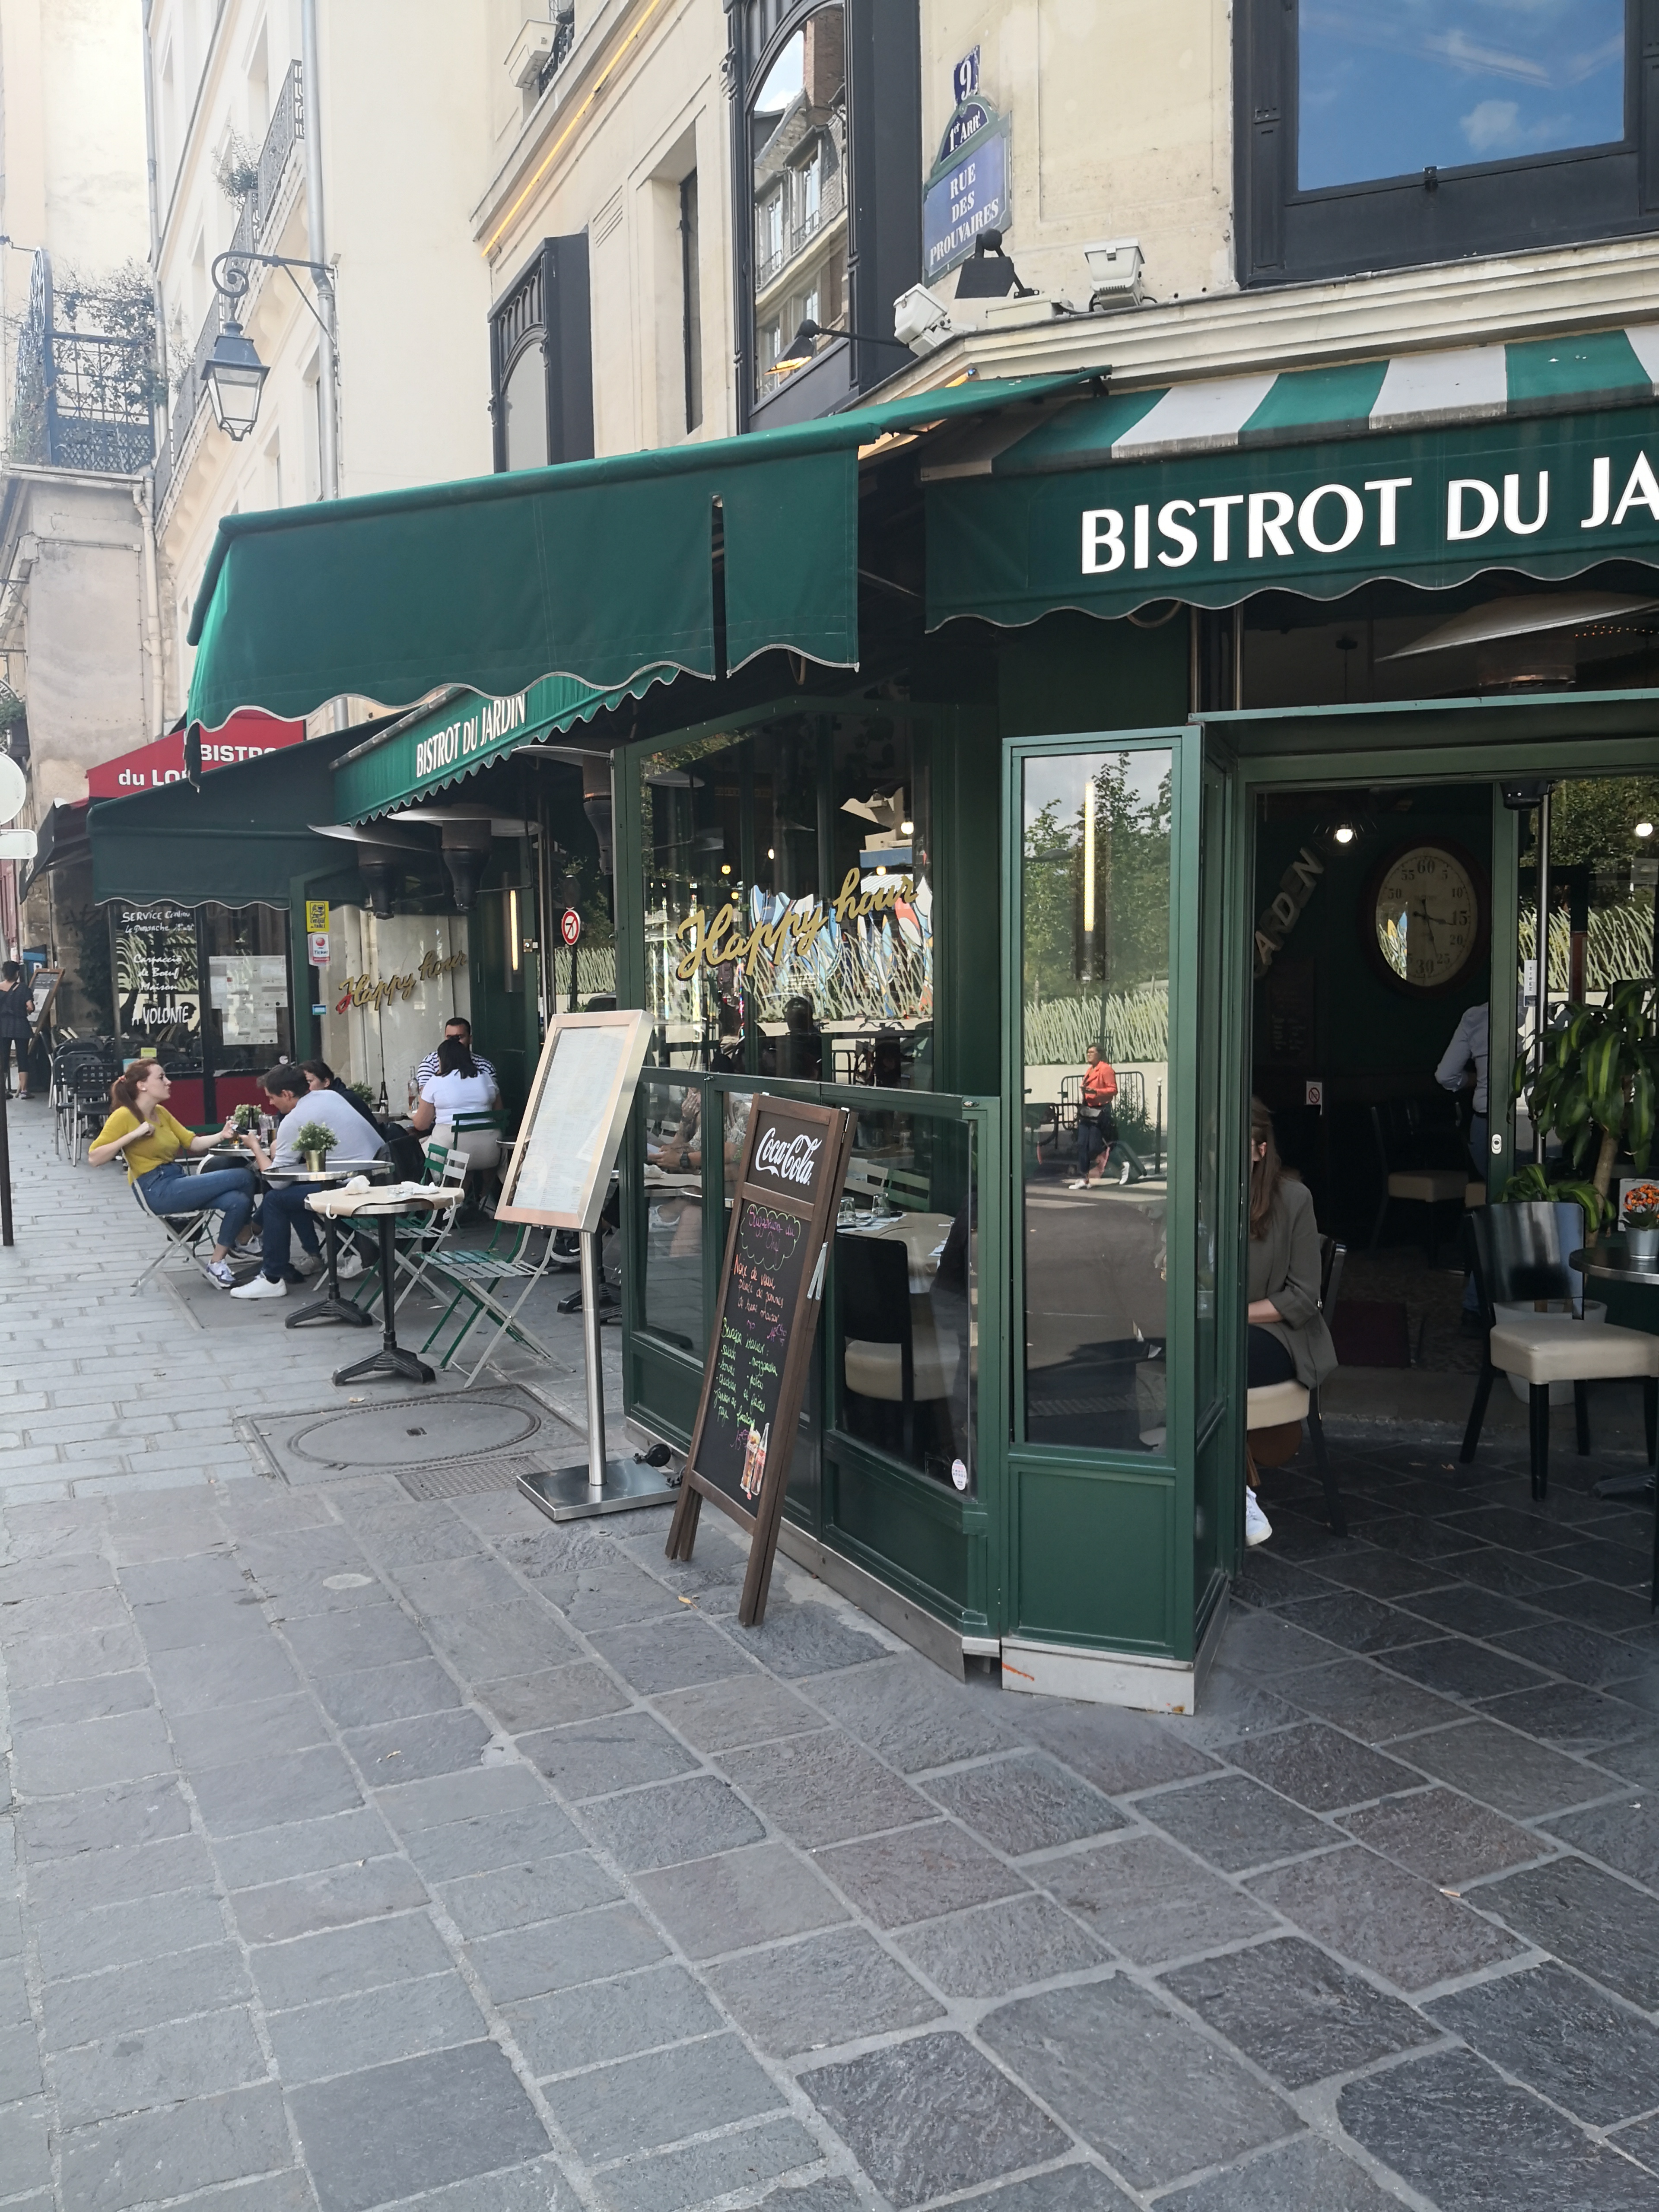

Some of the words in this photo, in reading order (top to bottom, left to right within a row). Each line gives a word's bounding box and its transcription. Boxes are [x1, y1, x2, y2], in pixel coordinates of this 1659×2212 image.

[960, 60, 971, 101] 9
[950, 163, 976, 199] RUE
[952, 191, 975, 223] DES
[930, 198, 999, 267] PROUVAIRES
[1081, 477, 1412, 575] BISTROT
[1447, 471, 1548, 541] DU
[416, 722, 461, 778] BISTROT
[463, 715, 478, 755] DU
[480, 694, 525, 747] JARDIN
[200, 744, 277, 762] BISTR
[118, 769, 144, 785] du
[1402, 870, 1414, 880] 55
[1417, 860, 1435, 874] 60
[1442, 870, 1448, 880] 5
[1388, 888, 1402, 899] 50
[1452, 888, 1463, 898] 10
[676, 903, 828, 981] Happy
[833, 868, 919, 922] hour
[1452, 910, 1468, 925] 15
[1450, 934, 1463, 945] 20
[1437, 953, 1450, 964] 25
[1416, 959, 1434, 975] 30
[336, 973, 417, 1014] Happy
[418, 950, 467, 981] hour
